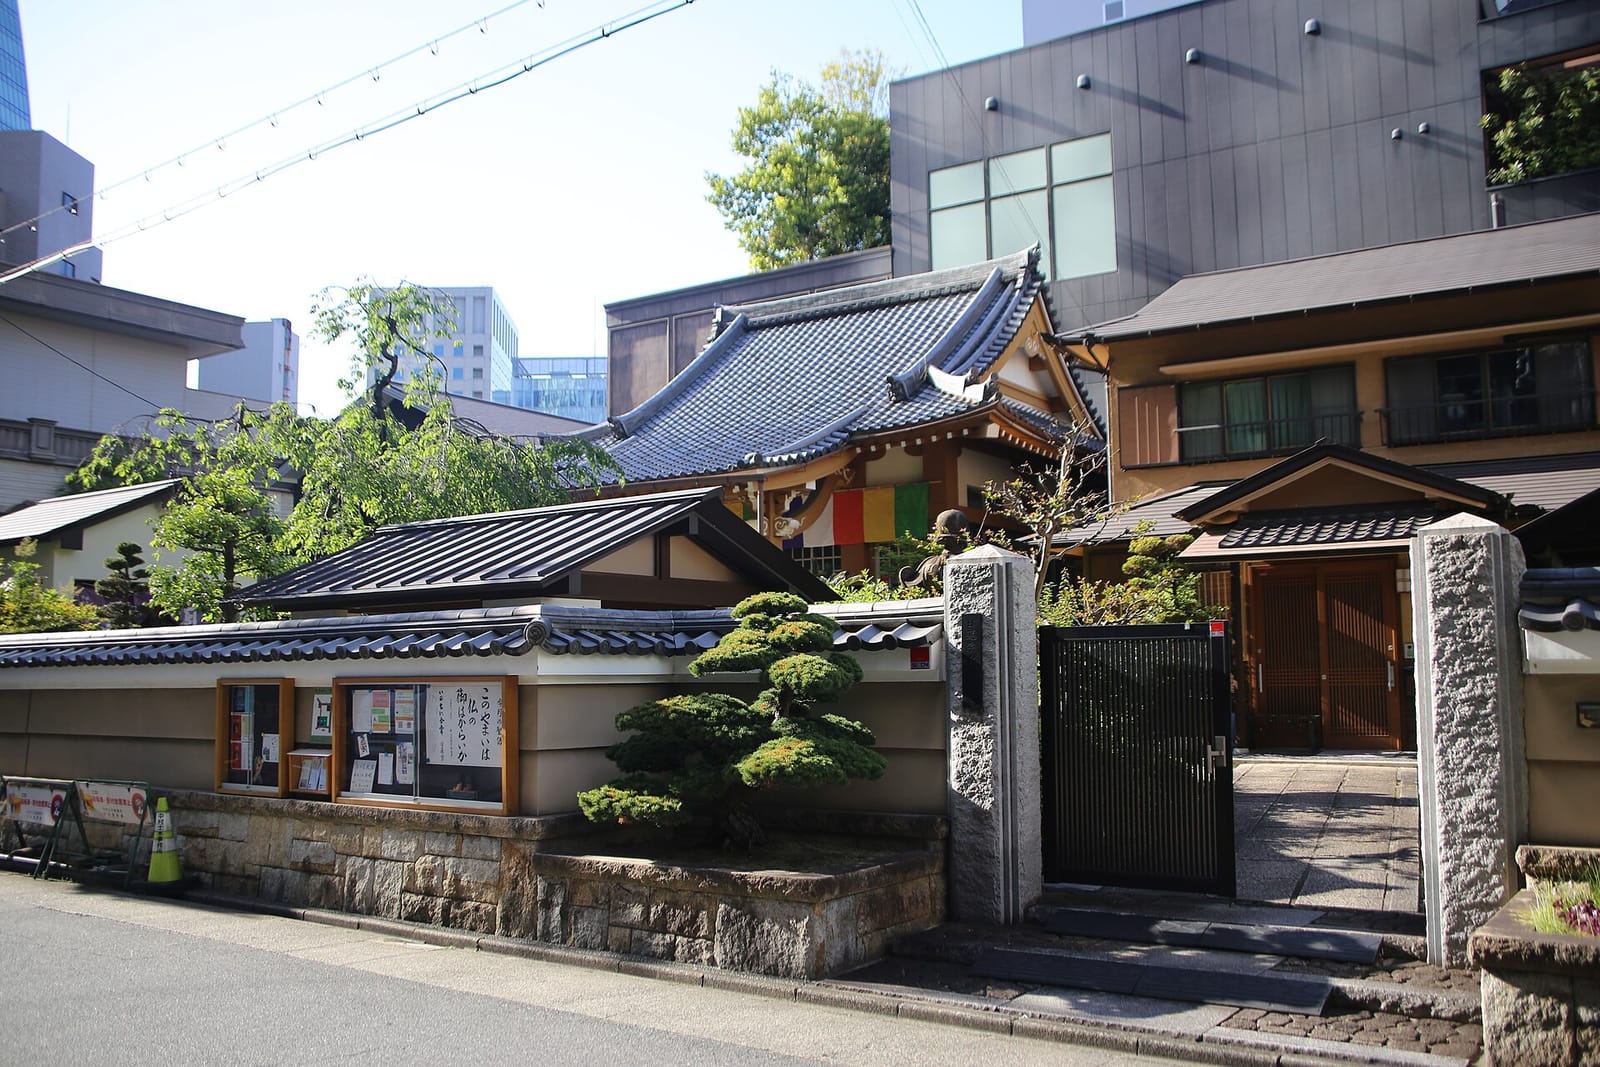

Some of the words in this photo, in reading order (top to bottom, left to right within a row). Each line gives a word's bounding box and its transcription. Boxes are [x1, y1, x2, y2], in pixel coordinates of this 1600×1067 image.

[456, 687, 468, 762] 御はからいか
[468, 697, 478, 726] 仏の
[481, 687, 491, 761] このやまいは
